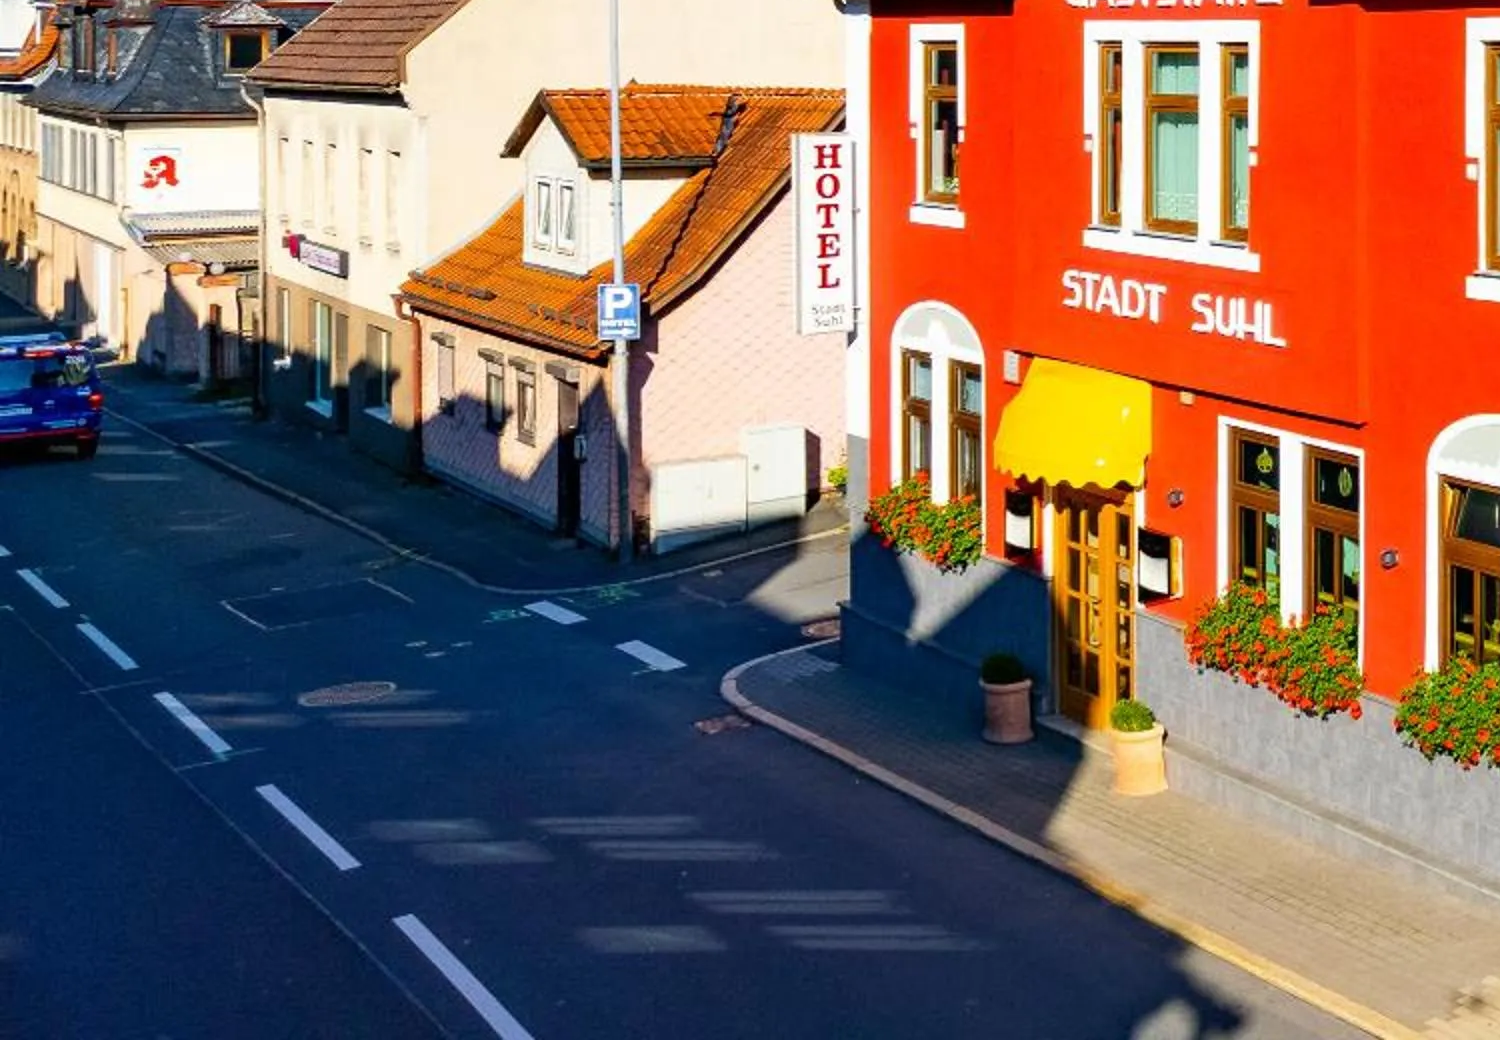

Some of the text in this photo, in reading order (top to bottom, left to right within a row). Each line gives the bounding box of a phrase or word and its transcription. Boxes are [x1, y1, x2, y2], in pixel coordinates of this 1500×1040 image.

[813, 144, 842, 289] HOTEL
[605, 287, 632, 319] P
[1062, 269, 1288, 348] STADT SUHL
